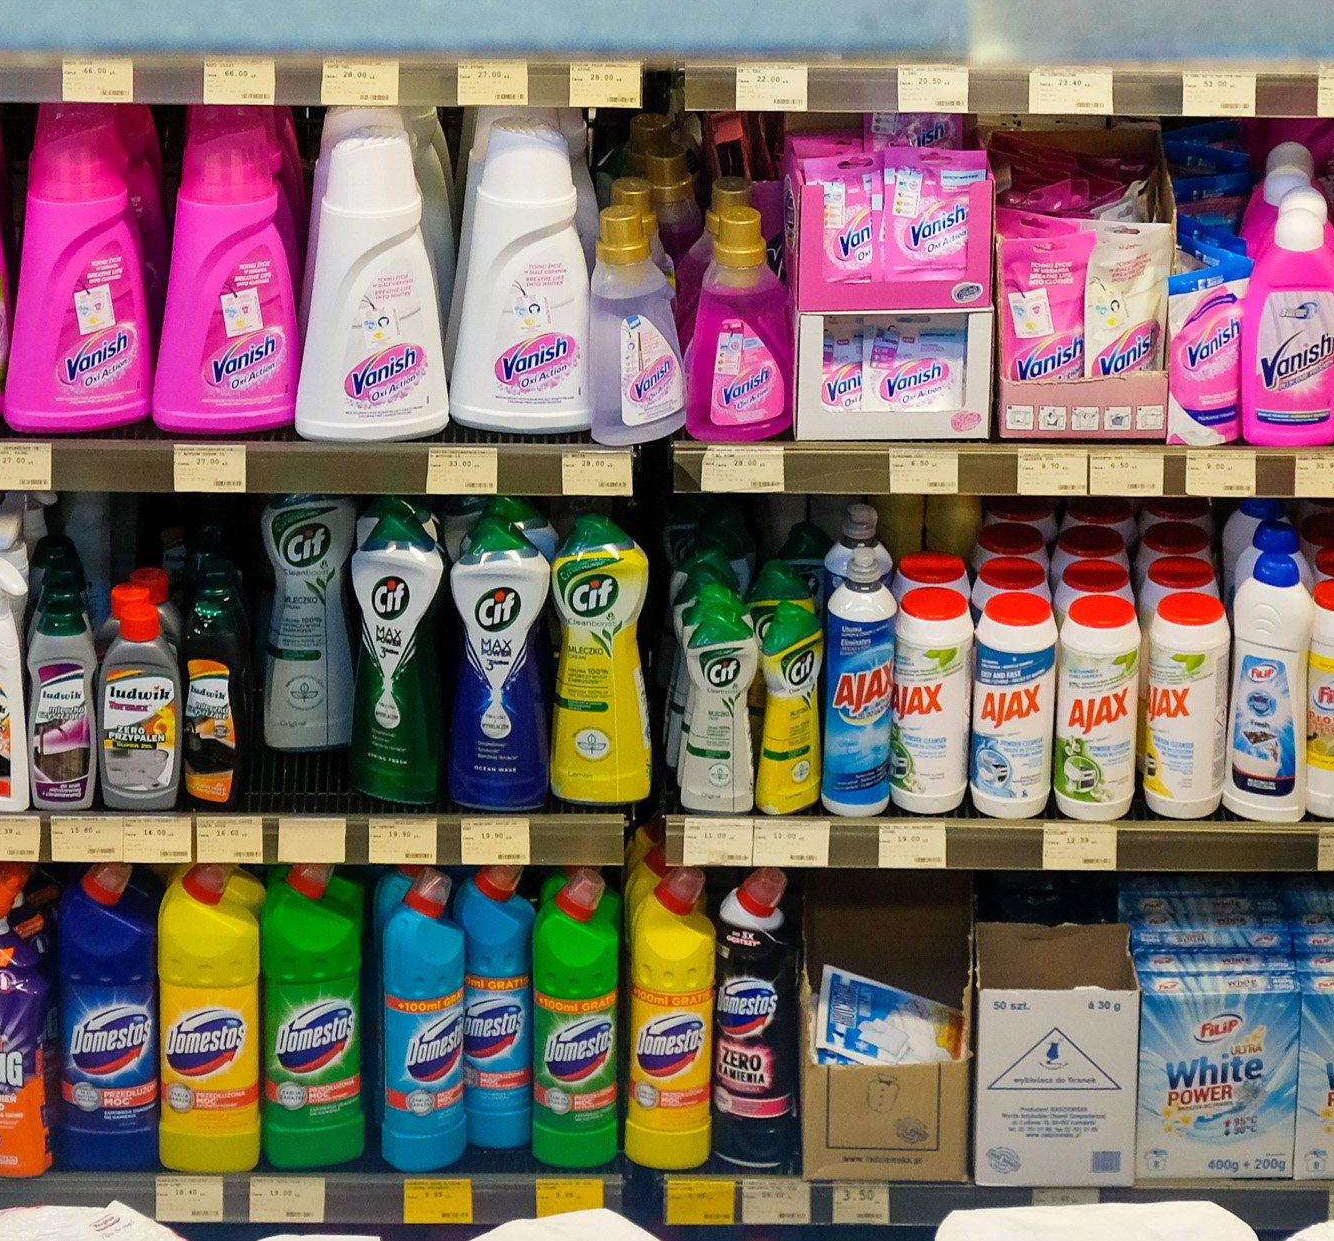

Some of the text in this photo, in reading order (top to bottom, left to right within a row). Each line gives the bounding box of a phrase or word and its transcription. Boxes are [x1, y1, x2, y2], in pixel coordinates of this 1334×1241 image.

[66, 332, 128, 380] Vanish
[212, 336, 276, 383] Vanish
[501, 336, 567, 381] Vanish
[351, 349, 417, 393] Vanish
[375, 580, 407, 612] Cif
[479, 592, 515, 624] Cif
[570, 577, 612, 610] Cif
[376, 626, 401, 640] MAX
[481, 638, 511, 653] MAX
[568, 646, 604, 656] MLECZKO
[42, 690, 82, 701] ludwik
[109, 685, 171, 701] ludwik
[834, 663, 893, 715] AJAX
[981, 684, 1040, 728] AJAX
[1069, 687, 1128, 733] AJAX
[108, 731, 165, 743] PRZYPALEŃ
[117, 726, 144, 735] ZERO
[718, 992, 778, 1014] Domestos
[71, 1019, 151, 1056] Domestos
[167, 1023, 245, 1055] Domestos
[277, 1017, 353, 1054] Domestos
[545, 1030, 612, 1062] Domestos
[637, 1029, 705, 1056] Domestos
[1230, 1044, 1262, 1056] ULTRA
[724, 1049, 761, 1071] ZERO
[1168, 1058, 1262, 1087] White
[722, 1068, 765, 1085] KAMIENIA
[1168, 1085, 1232, 1105] POWER
[843, 1189, 875, 1202] 3.50
